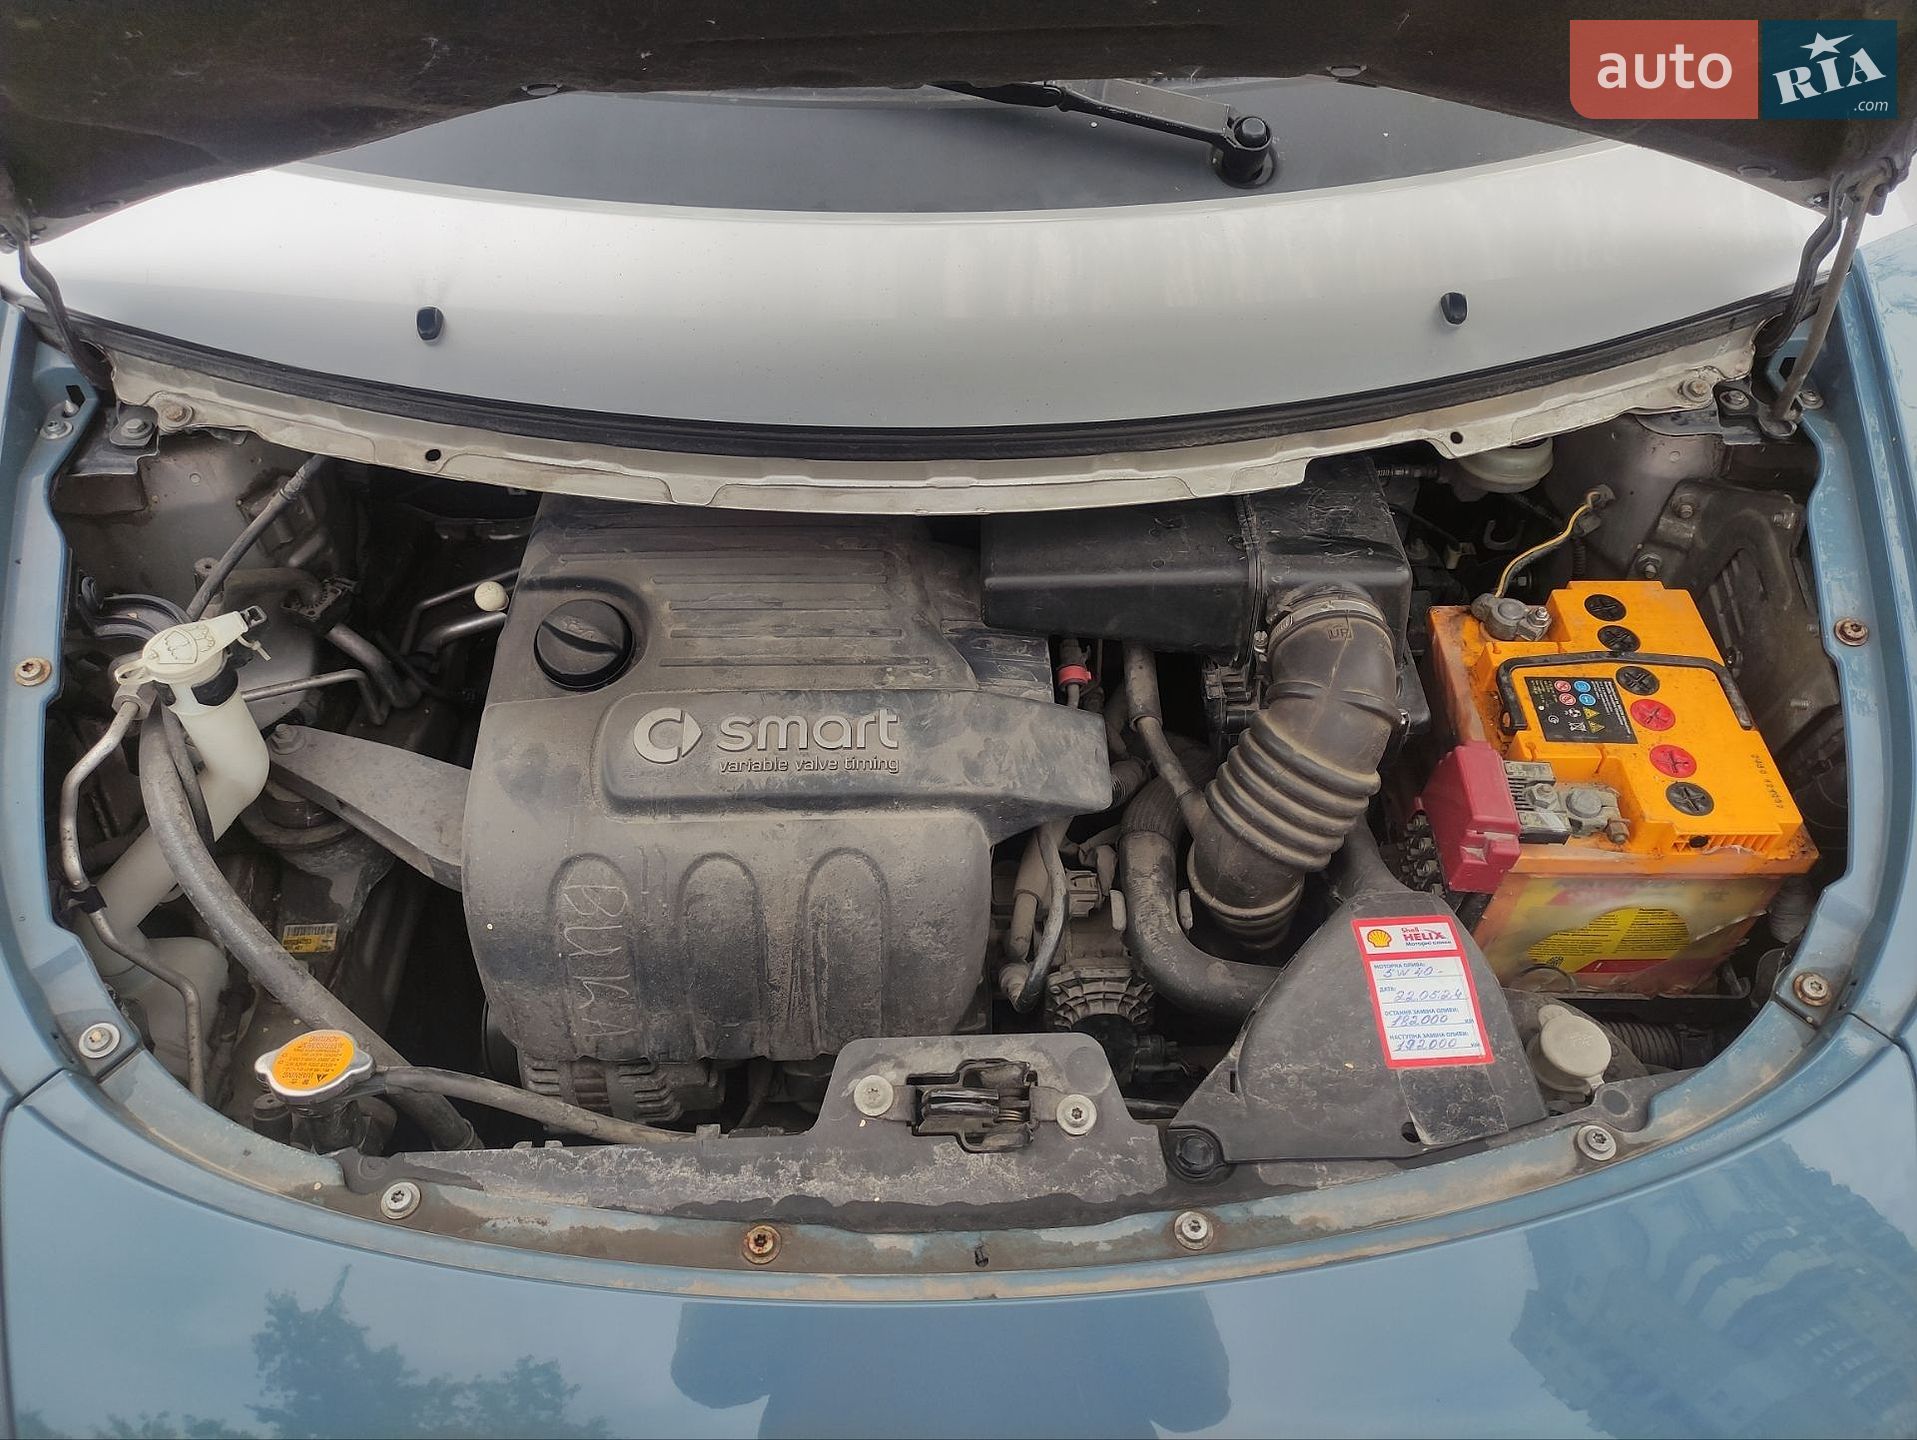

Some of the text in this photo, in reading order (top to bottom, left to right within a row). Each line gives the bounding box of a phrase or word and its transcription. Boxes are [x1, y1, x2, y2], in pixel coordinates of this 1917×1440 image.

[717, 709, 900, 752] smart
[719, 755, 900, 774] variable valve timing
[1403, 931, 1446, 942] HELIX
